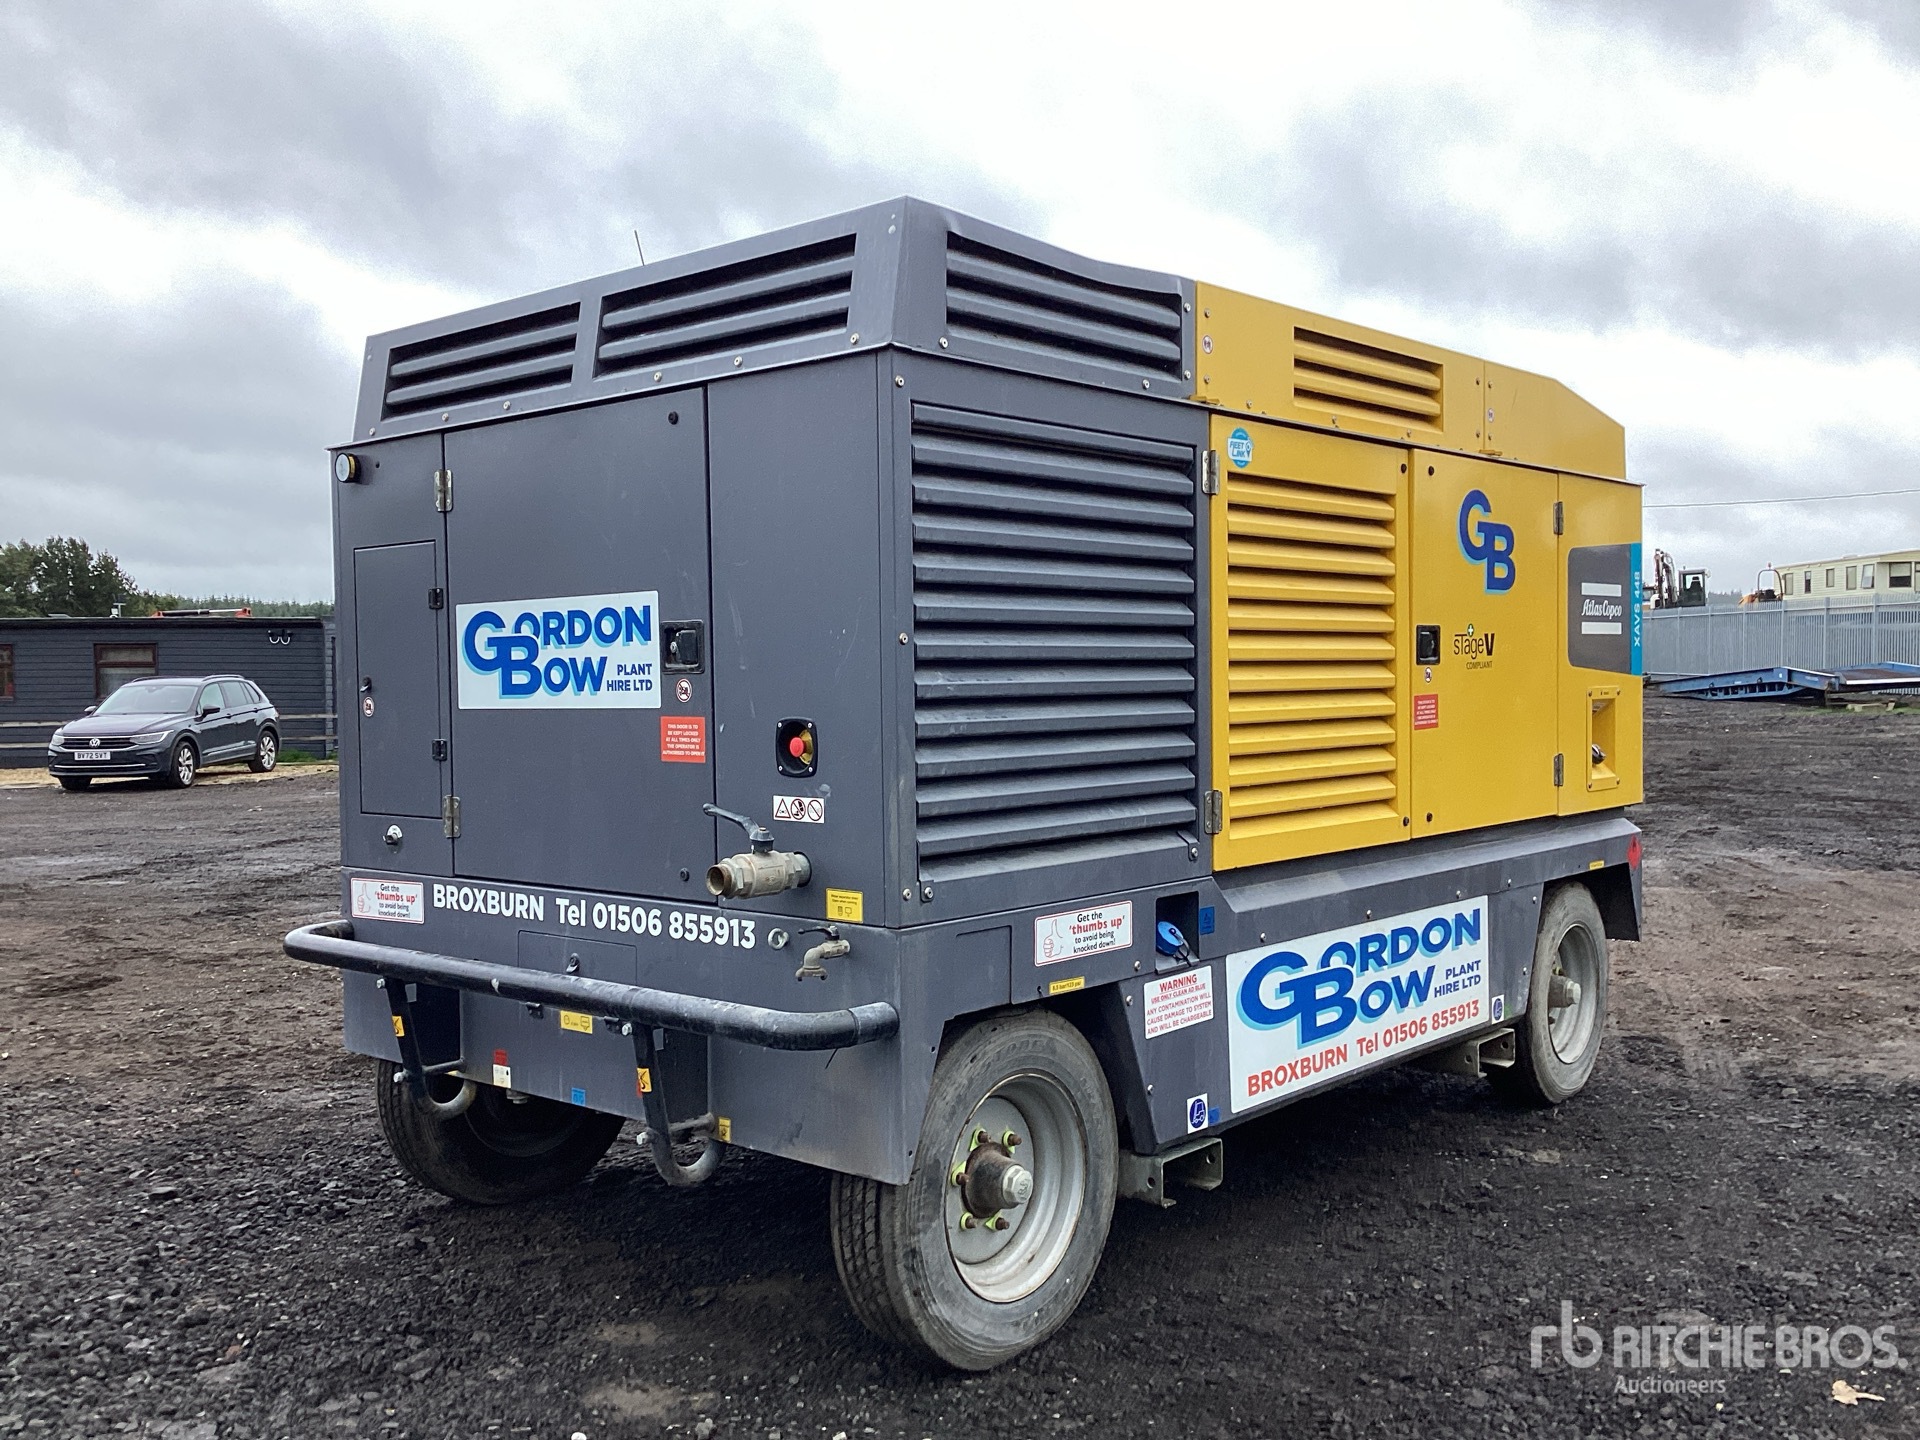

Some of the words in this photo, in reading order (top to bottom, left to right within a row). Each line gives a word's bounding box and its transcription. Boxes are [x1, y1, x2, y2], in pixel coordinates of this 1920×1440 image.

[1458, 489, 1516, 594] GB
[1581, 599, 1602, 616] Atlas
[1602, 600, 1622, 620] Copco
[1633, 603, 1641, 647] XAVS
[462, 605, 652, 674] GORDON
[499, 636, 608, 698] BOW
[616, 663, 652, 676] PLANT
[1466, 661, 1493, 670] COMPLIANT
[606, 680, 631, 692] HIRE
[633, 680, 653, 691] LTD
[397, 903, 409, 912] being
[433, 884, 544, 921] BROXBURN
[555, 898, 586, 927] Tel
[593, 903, 662, 936] 01506
[669, 911, 756, 949] 855913
[1077, 914, 1090, 922] Get
[1091, 911, 1103, 920] the
[1073, 943, 1097, 953] knocked
[1098, 938, 1116, 949] down!
[1082, 933, 1097, 943] avoid
[1099, 930, 1114, 940] being
[1239, 908, 1481, 1026] GORDON
[1445, 960, 1481, 979] PLANT
[1159, 974, 1197, 992] WARNING
[1161, 993, 1172, 1001] ONLY
[1173, 988, 1187, 997] CLEAN
[1434, 982, 1459, 998] HIRE
[1462, 974, 1482, 990] LTD
[1147, 1008, 1157, 1016] ANY
[1158, 995, 1199, 1012] CONTAMINATION
[1199, 992, 1211, 1000] WILL
[1147, 1014, 1163, 1025] CAUSE
[1164, 1009, 1185, 1020] DAMAGE
[1194, 1001, 1211, 1011] SYSTEM
[1298, 965, 1436, 1047] BOW
[1147, 1026, 1158, 1034] AND
[1159, 1022, 1172, 1030] WILL
[1173, 1019, 1179, 1027] BE
[1180, 1009, 1212, 1024] CHARGEABLE
[1248, 1044, 1348, 1097] BROXBURN
[1356, 1032, 1378, 1057] Tel
[1383, 1016, 1427, 1047] 01506
[1431, 999, 1479, 1031] 855913
